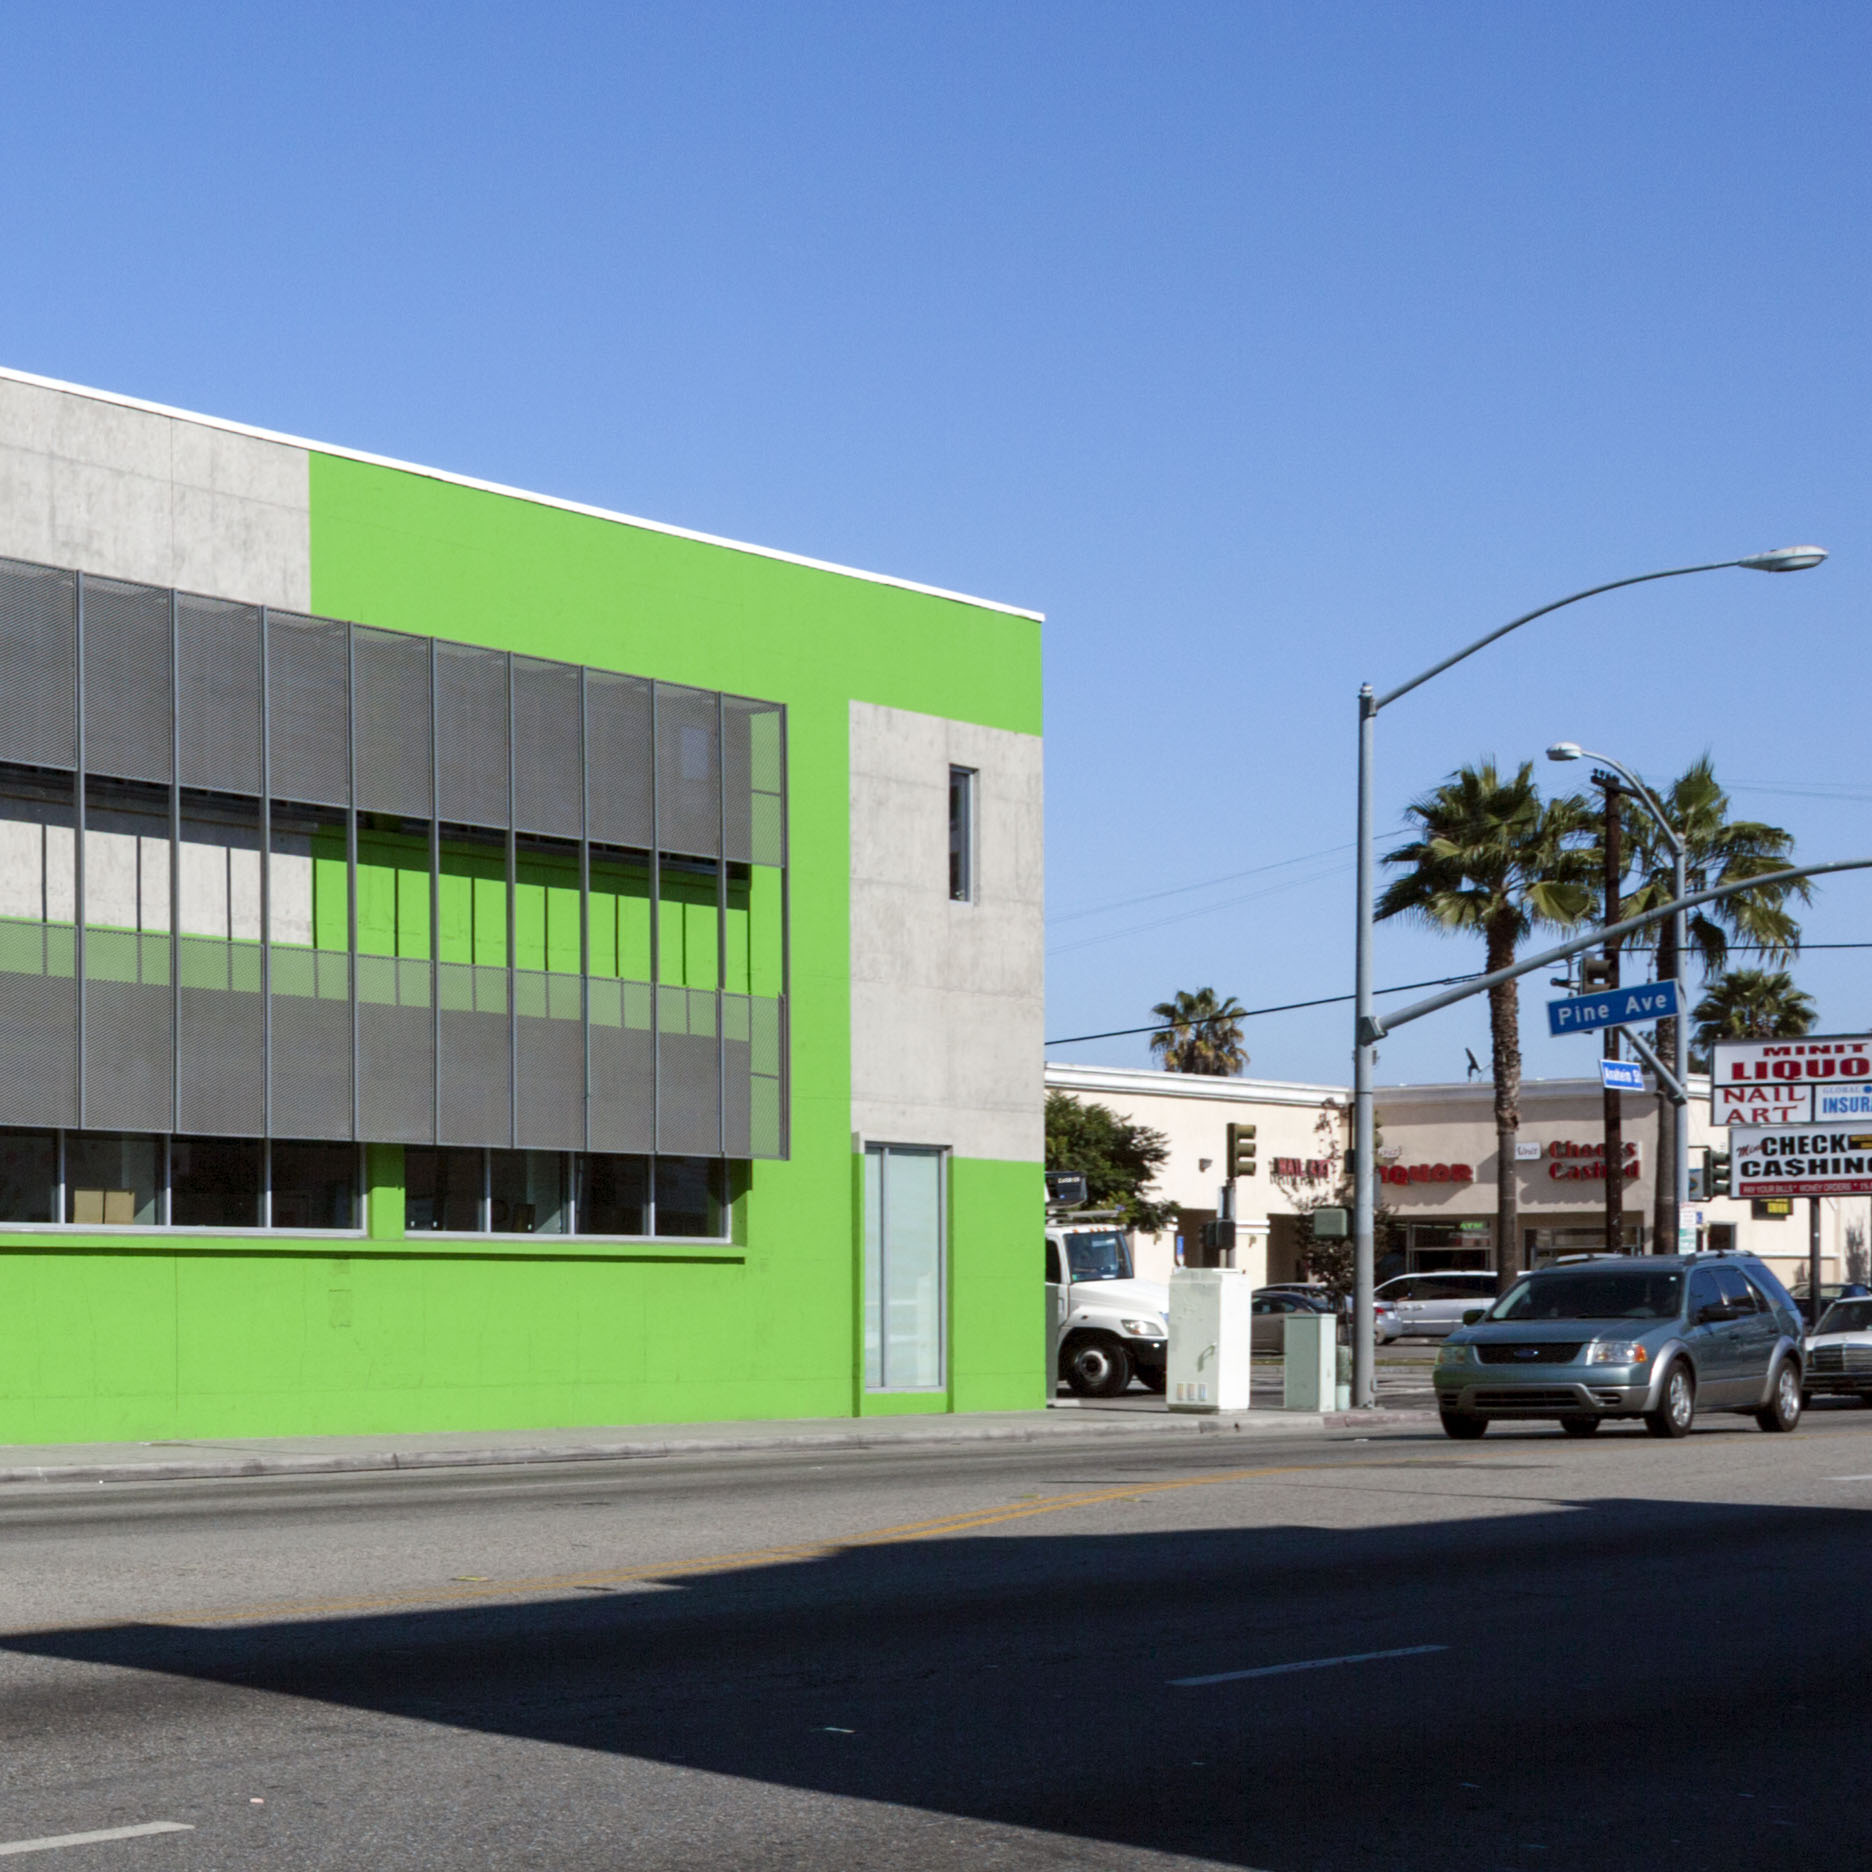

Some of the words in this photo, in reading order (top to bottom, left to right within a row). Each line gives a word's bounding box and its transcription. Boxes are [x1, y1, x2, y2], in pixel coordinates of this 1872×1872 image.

[1558, 1003, 1609, 1026] Pine
[1625, 994, 1667, 1014] Ave
[1763, 1043, 1869, 1057] MINIT
[1722, 1085, 1806, 1104] NAIL
[1822, 1096, 1872, 1113] INSUR
[1725, 1105, 1798, 1124] ART
[1548, 1140, 1637, 1158] Checs
[1761, 1133, 1848, 1156] CHECK
[1378, 1163, 1473, 1185] IQUOR
[1548, 1160, 1640, 1180] Cashd
[1740, 1156, 1872, 1178] CA$HIN
